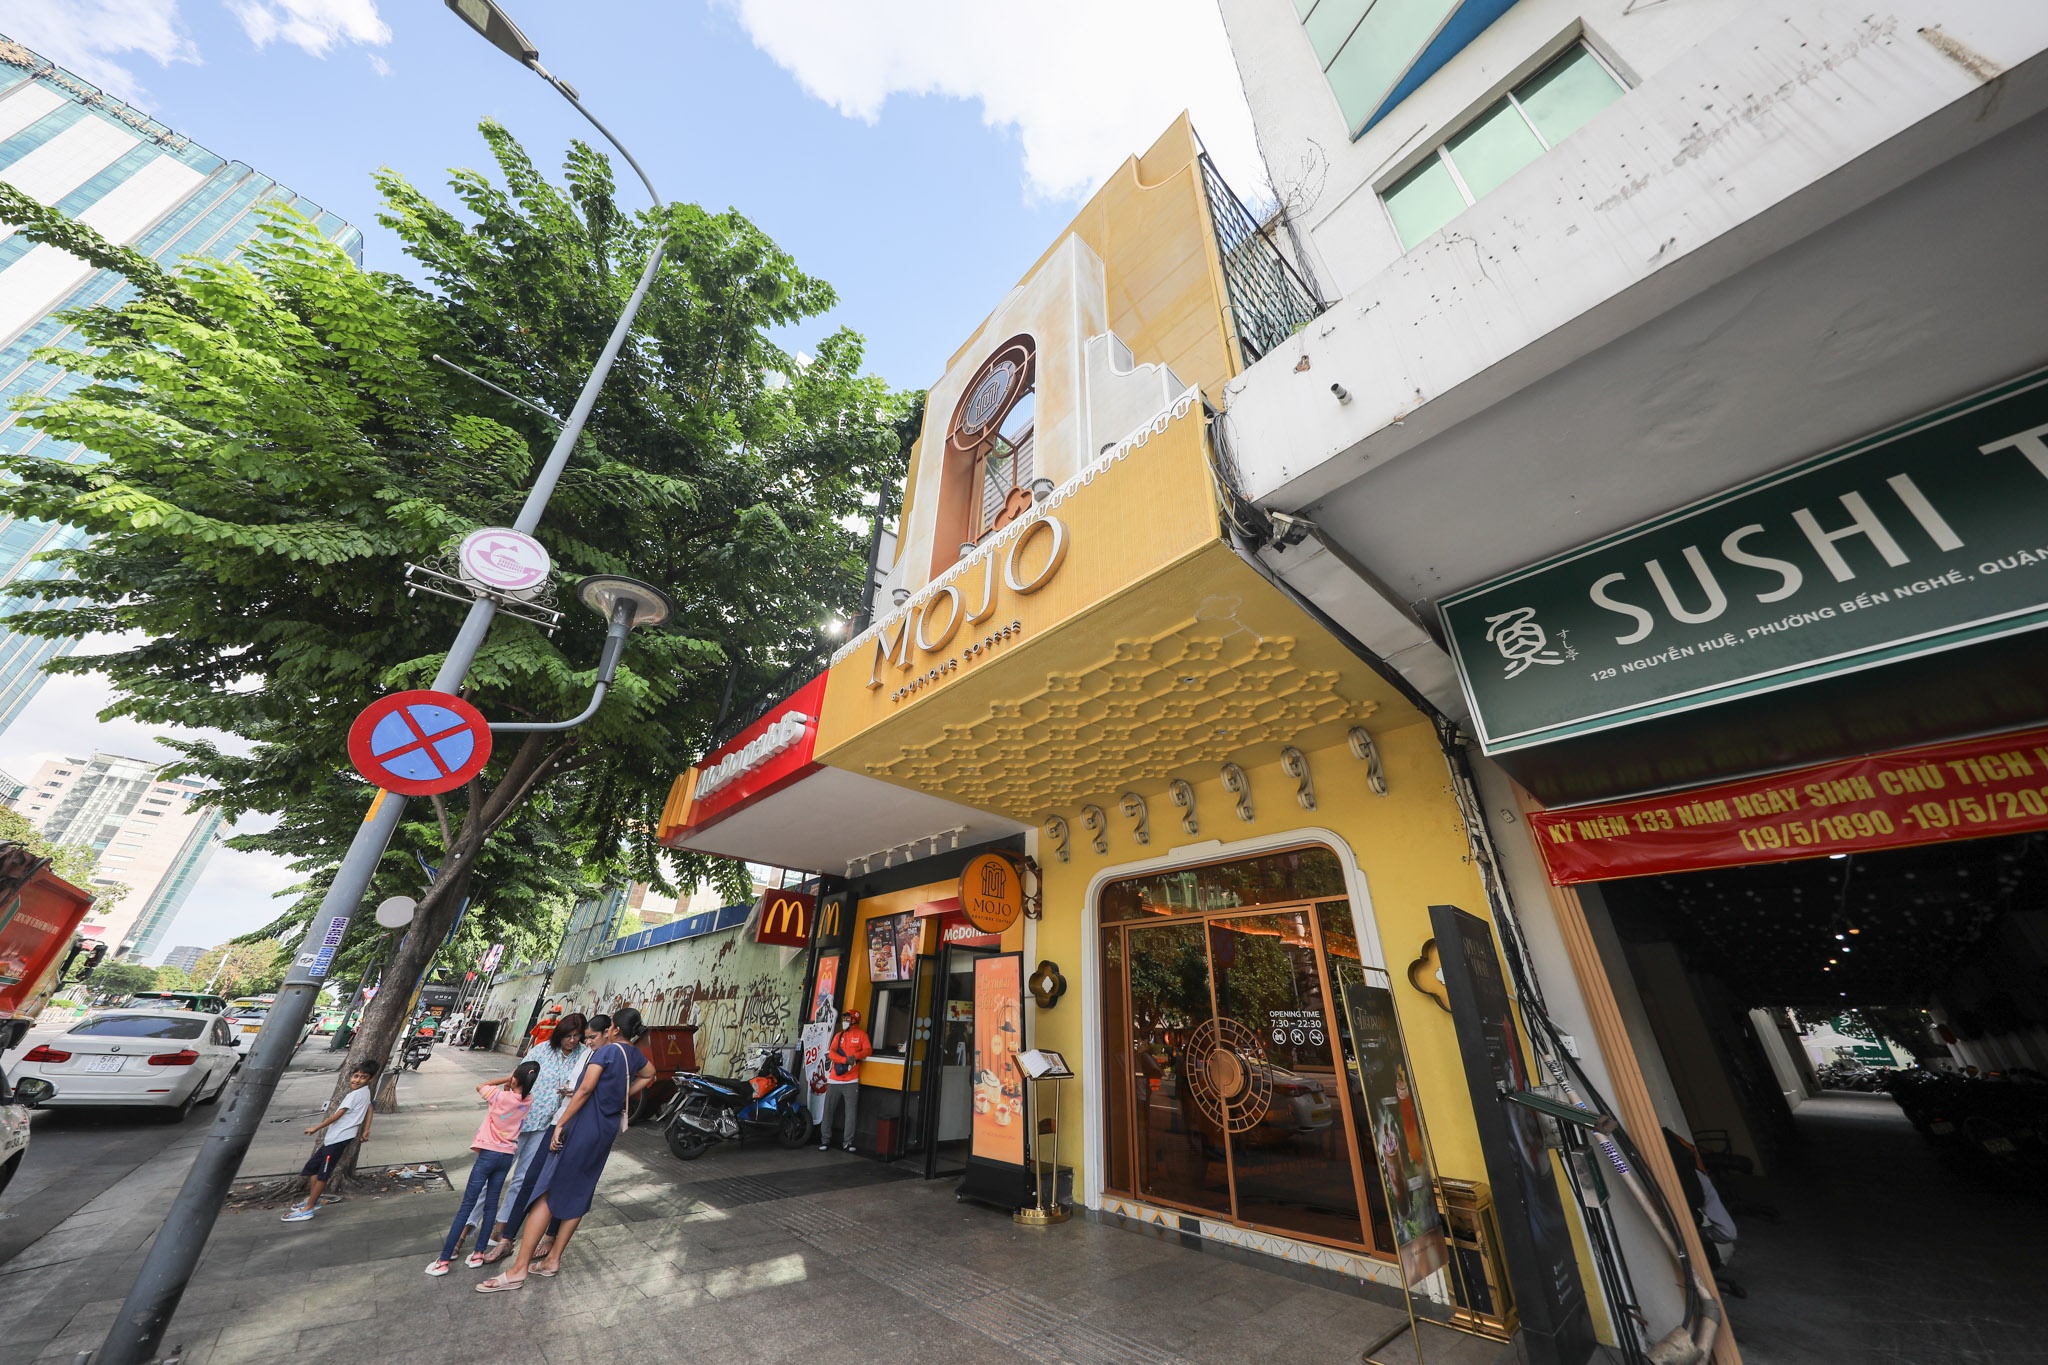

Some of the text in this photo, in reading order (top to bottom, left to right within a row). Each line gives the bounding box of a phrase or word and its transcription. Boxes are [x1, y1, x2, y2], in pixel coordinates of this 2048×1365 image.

[1589, 473, 1964, 645] SUSHI
[866, 515, 1069, 691] MOJO
[1590, 667, 1617, 682] 129
[1621, 646, 1695, 674] NGUYỄN
[1747, 607, 1836, 640] PHƯỜNG
[1840, 592, 1890, 614] BẾN
[1893, 569, 1975, 599] NGHÉ,
[891, 620, 1021, 702] BOUTIQUE COFFEE
[1548, 819, 1574, 844] KỶ
[1577, 815, 1630, 842] NIỆM
[1632, 808, 1674, 833] 133
[1676, 800, 1732, 827] NĂM
[1733, 787, 1799, 818] NGÀY
[1804, 775, 1876, 807] SINH
[1878, 760, 1946, 796] CHỦ
[1946, 751, 2035, 788] TỊCH
[1738, 810, 1895, 851] (19/5/1890
[973, 898, 1011, 917] MOJO
[1269, 1010, 1320, 1018] OPENING TIME
[1270, 1019, 1289, 1028] 7:30
[1297, 1019, 1322, 1028] 22:30
